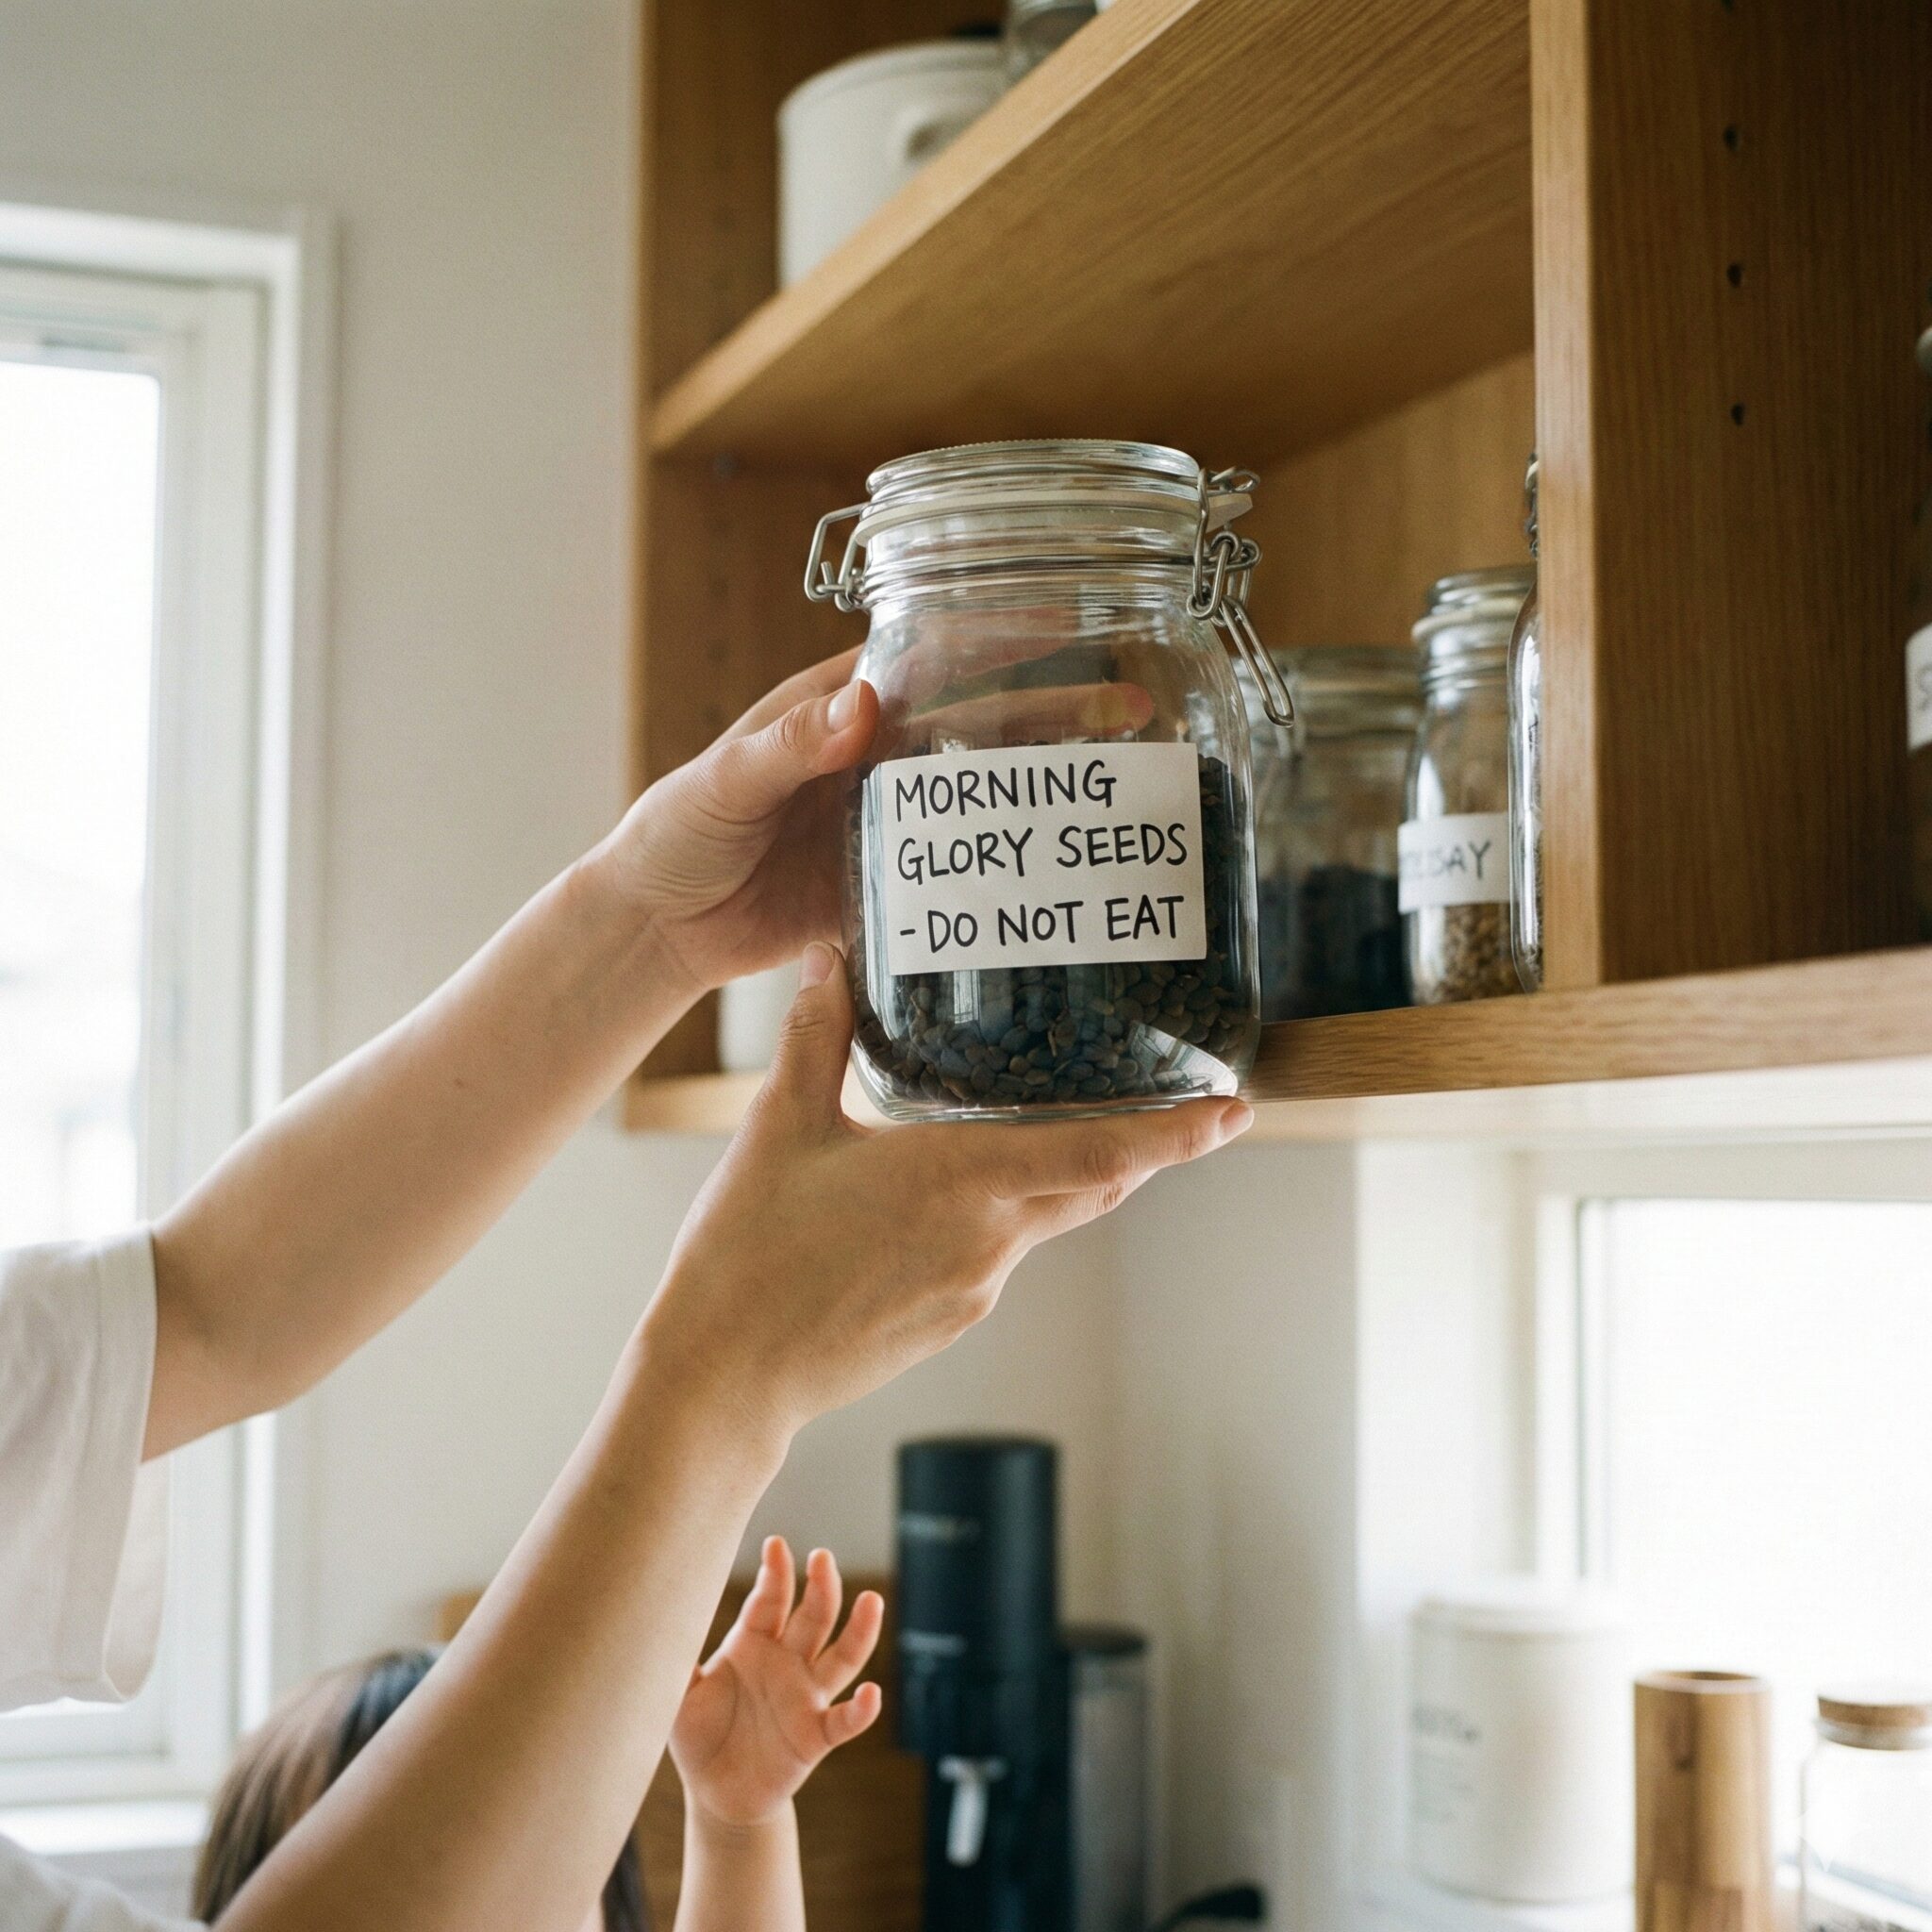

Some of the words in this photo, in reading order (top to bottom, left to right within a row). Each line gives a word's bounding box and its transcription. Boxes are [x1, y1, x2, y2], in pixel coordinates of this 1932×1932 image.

[895, 758, 1118, 823] MORNING
[897, 826, 1034, 886] GLORY
[1056, 822, 1188, 869] SEEDS
[900, 909, 978, 954] -DO
[997, 900, 1084, 946] NOT
[1104, 893, 1185, 941] EAT
